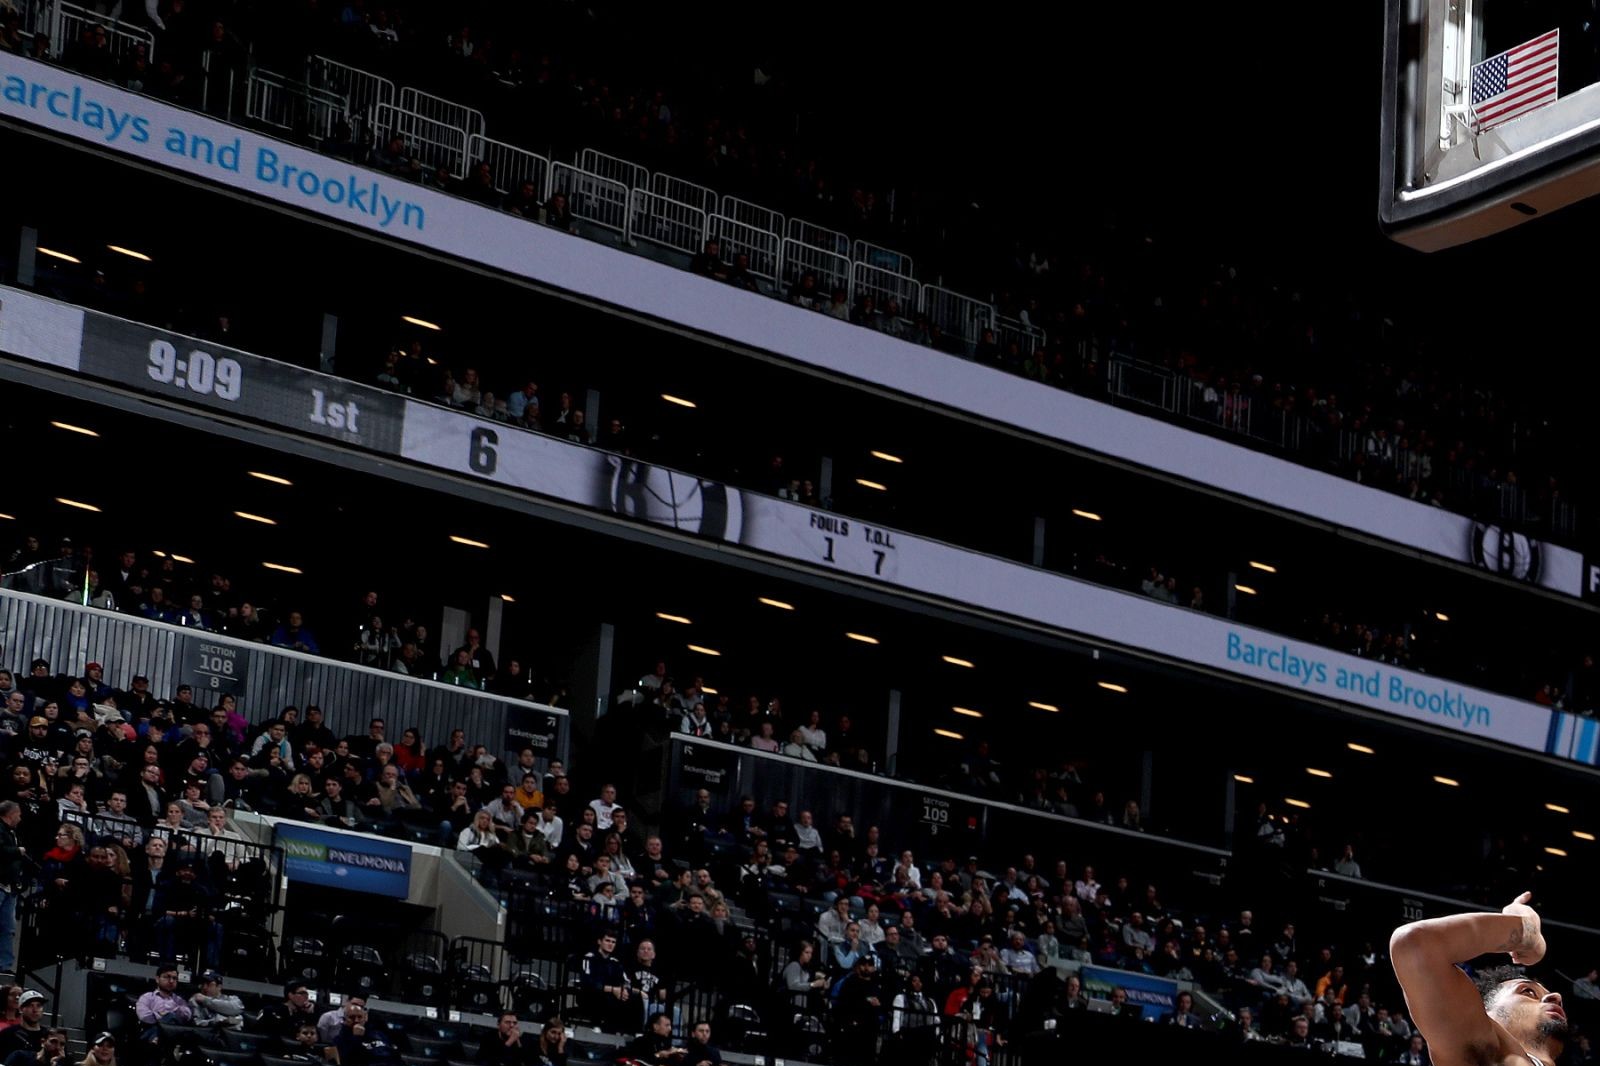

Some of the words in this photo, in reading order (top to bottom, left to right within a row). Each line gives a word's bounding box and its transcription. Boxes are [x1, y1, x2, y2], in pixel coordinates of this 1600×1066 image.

[0, 74, 150, 142] arclays
[165, 125, 241, 173] and
[257, 148, 425, 232] Brooklyn
[147, 339, 242, 402] 9:09
[308, 389, 361, 434] 1st
[469, 427, 499, 476] 6
[810, 513, 849, 538] FOULS
[822, 537, 835, 563] 1
[874, 550, 886, 576] 7
[200, 643, 237, 662] SECTION
[200, 654, 234, 675] 108
[209, 677, 220, 689] 8
[1226, 632, 1328, 690] Barclays
[1336, 662, 1380, 698] and
[1388, 671, 1491, 727] Brooklyn
[922, 804, 949, 823] 109
[329, 850, 406, 873] PNEUMONIA
